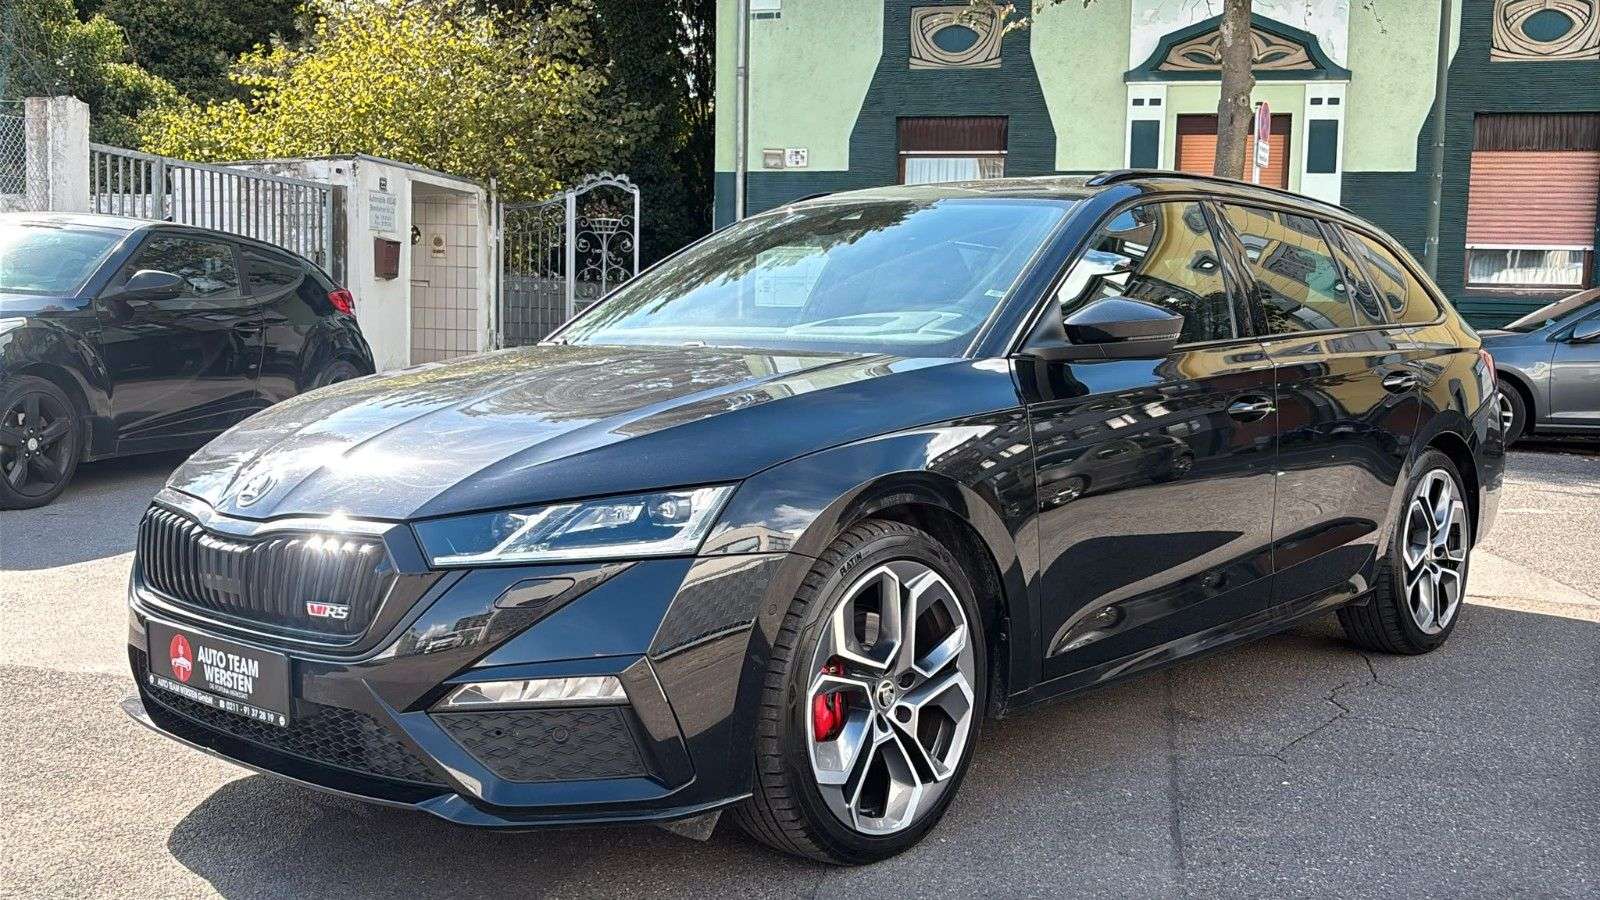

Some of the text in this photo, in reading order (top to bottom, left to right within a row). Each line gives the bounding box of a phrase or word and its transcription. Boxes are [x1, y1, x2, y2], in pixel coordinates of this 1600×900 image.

[840, 552, 862, 577] PLATIN
[198, 645, 259, 678] AUTO TEAM
[203, 663, 253, 694] WERSTEN
